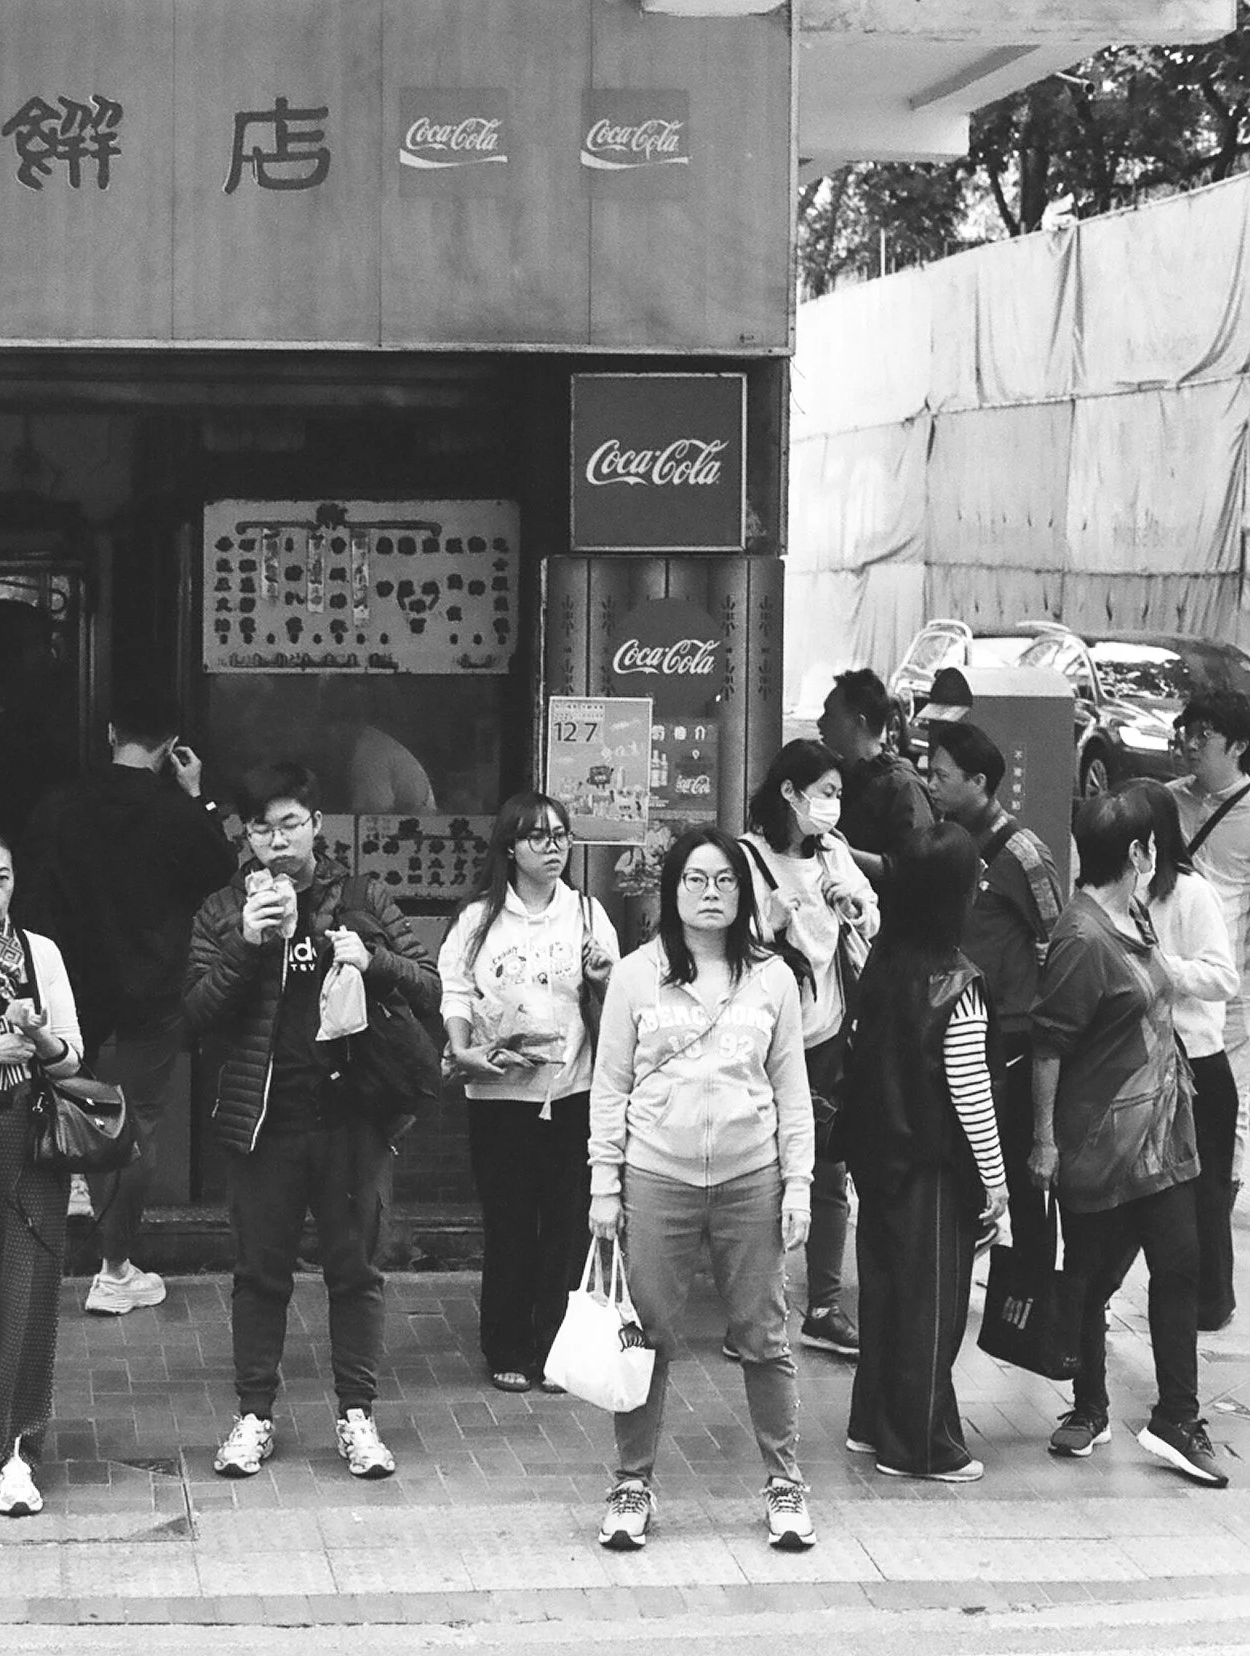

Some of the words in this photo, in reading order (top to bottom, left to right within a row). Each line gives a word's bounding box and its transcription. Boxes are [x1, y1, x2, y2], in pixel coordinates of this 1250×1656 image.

[406, 117, 503, 151] Coca-Cola
[586, 119, 684, 152] Coca-Cola
[586, 439, 730, 485] Coca-Cola
[612, 639, 722, 675] Coca-Cola
[553, 721, 578, 742] 12
[584, 721, 599, 742] 7
